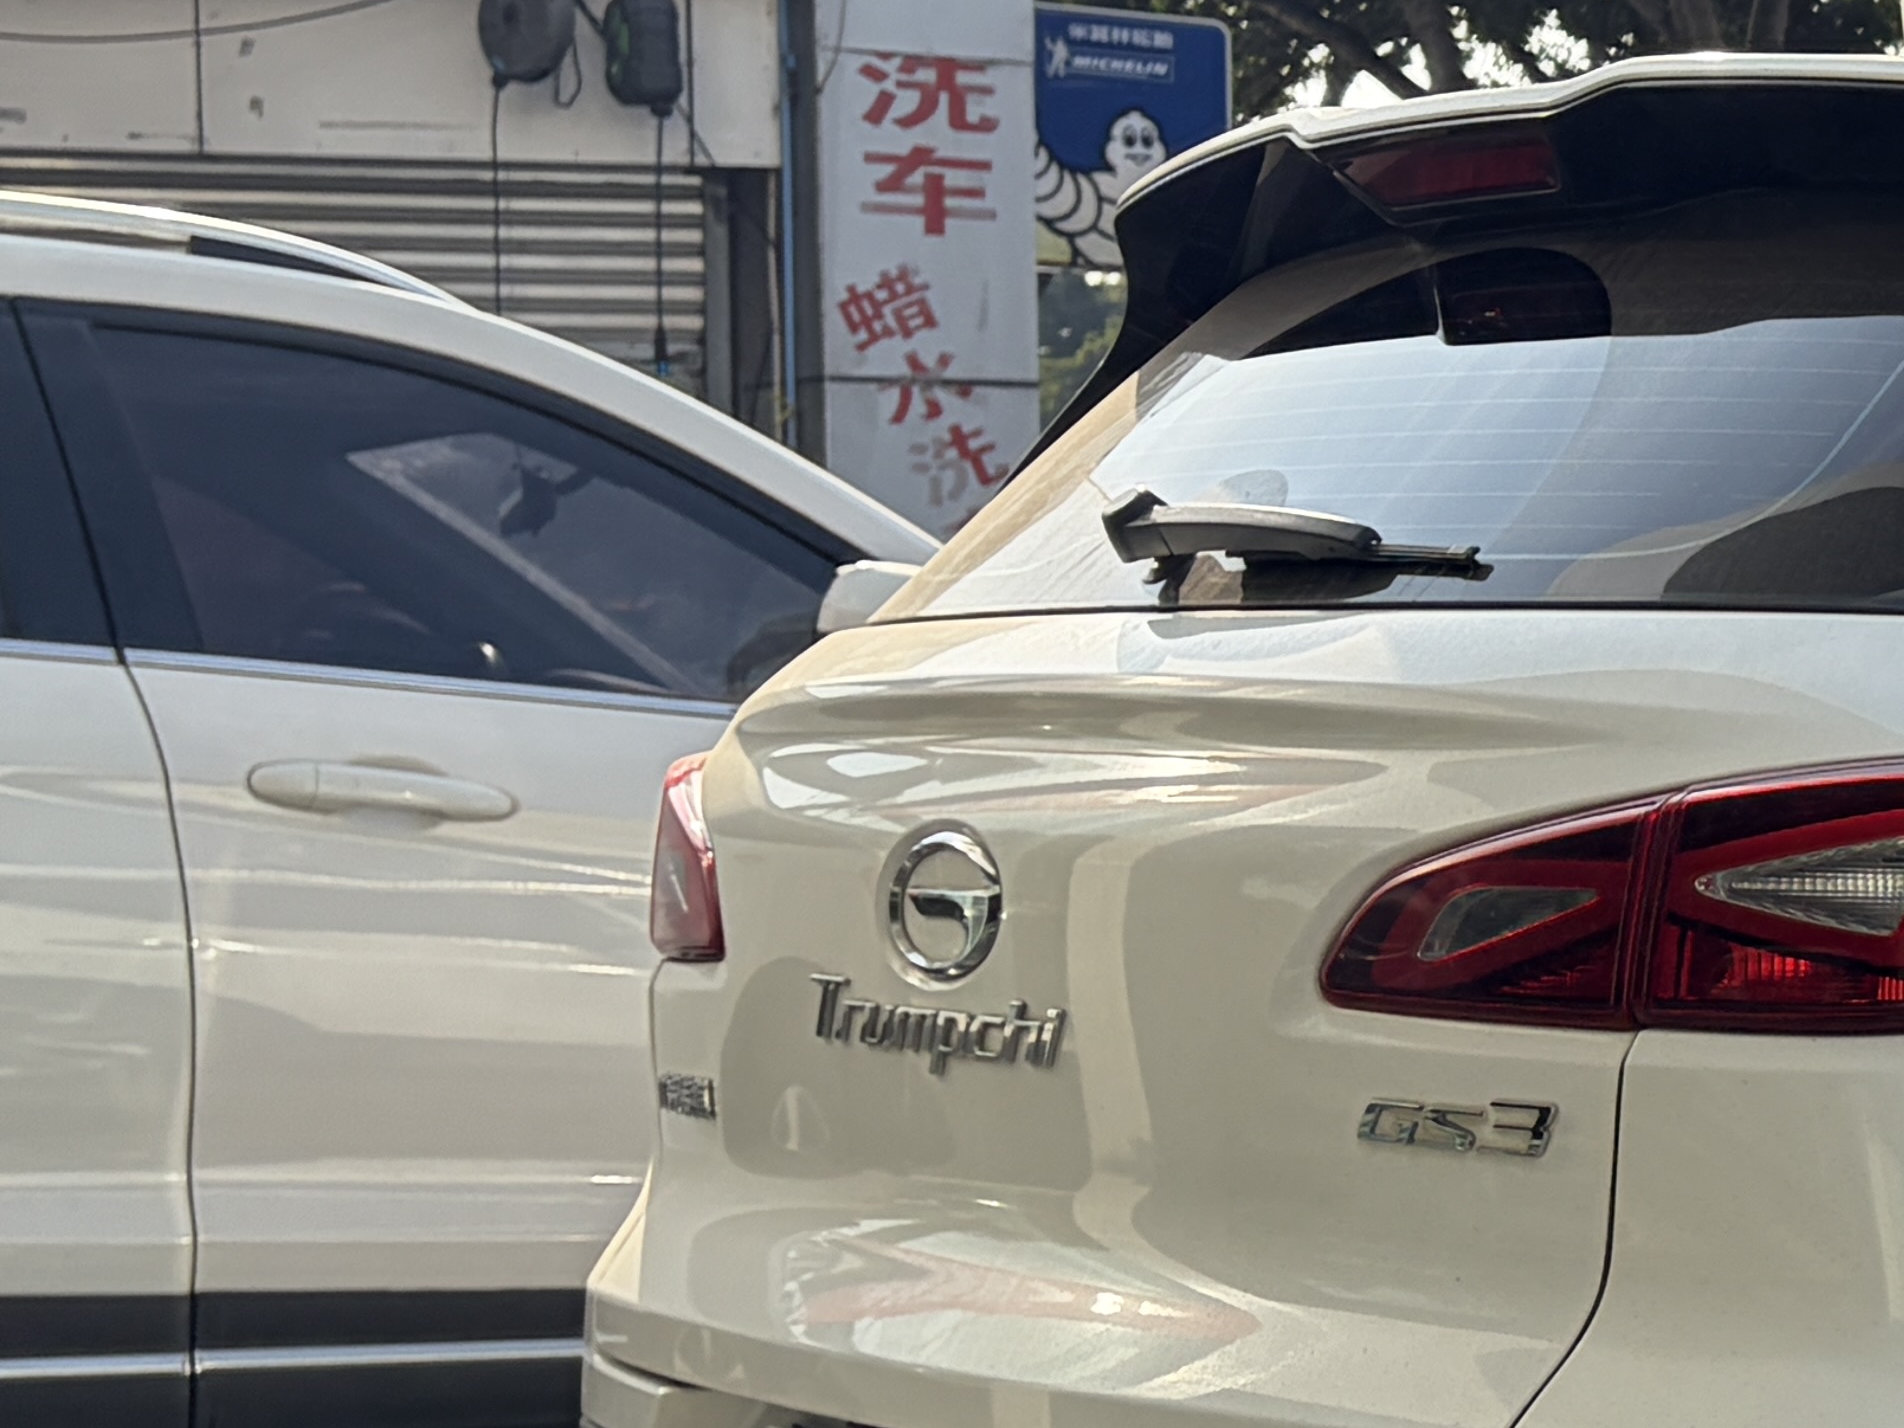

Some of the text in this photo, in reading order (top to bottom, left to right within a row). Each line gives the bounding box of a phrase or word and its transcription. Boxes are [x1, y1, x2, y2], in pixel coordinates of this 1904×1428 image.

[1073, 55, 1169, 77] MICHELIN
[857, 52, 1000, 236] 洗车
[837, 264, 1011, 534] 蜡水洗
[808, 972, 1066, 1076] Trumpchi
[1356, 1095, 1560, 1159] GS3
